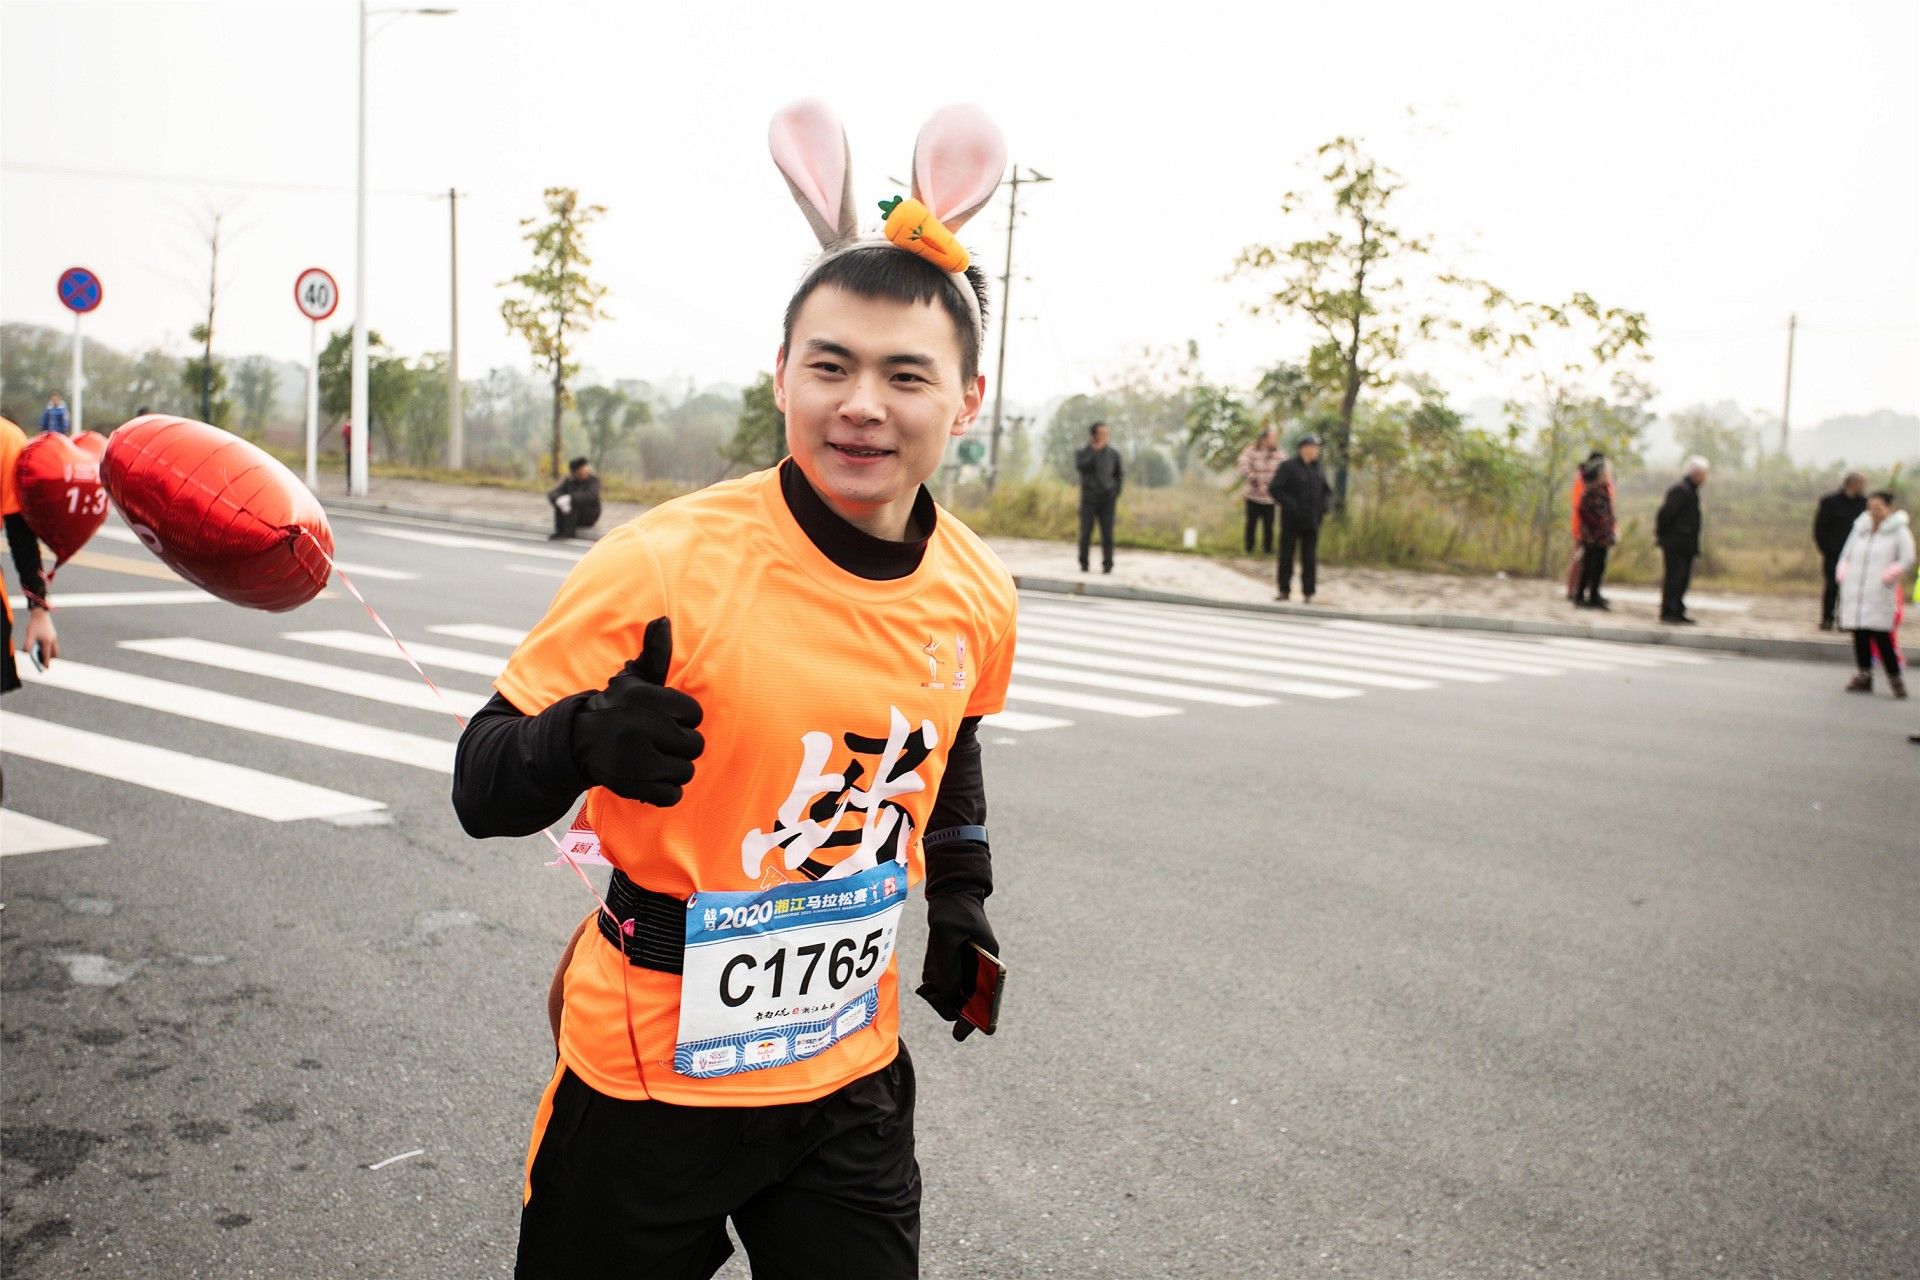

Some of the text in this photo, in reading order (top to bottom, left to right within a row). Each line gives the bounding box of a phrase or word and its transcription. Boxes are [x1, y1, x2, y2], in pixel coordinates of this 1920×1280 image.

[304, 284, 328, 308] 40
[718, 901, 773, 930] 2020
[719, 928, 883, 1008] C1765
